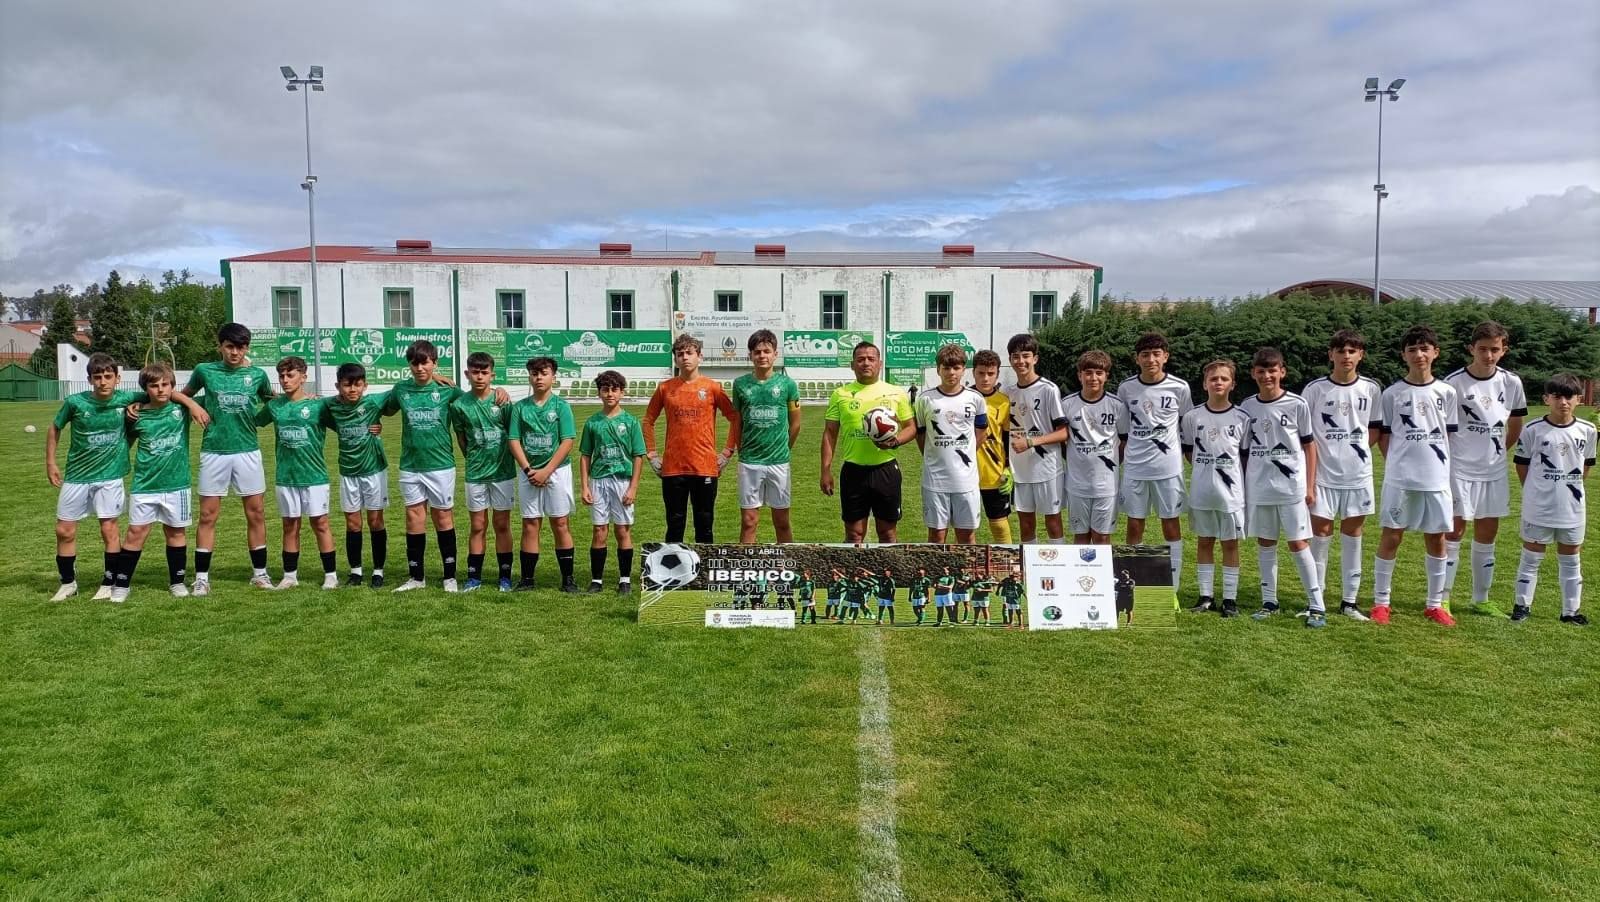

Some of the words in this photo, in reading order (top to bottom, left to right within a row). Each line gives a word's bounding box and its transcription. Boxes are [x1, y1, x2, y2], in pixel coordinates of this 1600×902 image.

[298, 329, 337, 337] DELADO
[886, 345, 937, 353] ROGOMSA
[1160, 396, 1172, 409] 12
[1497, 391, 1505, 404] 4
[1034, 398, 1041, 411] 2
[1358, 397, 1368, 411] 11
[1436, 398, 1443, 411] 9
[407, 409, 440, 420] CONDE
[750, 408, 779, 418] CONDE
[964, 406, 971, 418] 5
[1100, 413, 1115, 425] 20
[1280, 414, 1288, 427] 6
[1227, 424, 1235, 437] 3
[708, 558, 725, 569] III
[728, 558, 797, 569] TORNEO
[708, 567, 795, 581] IBÉRICO
[707, 583, 730, 593] DE
